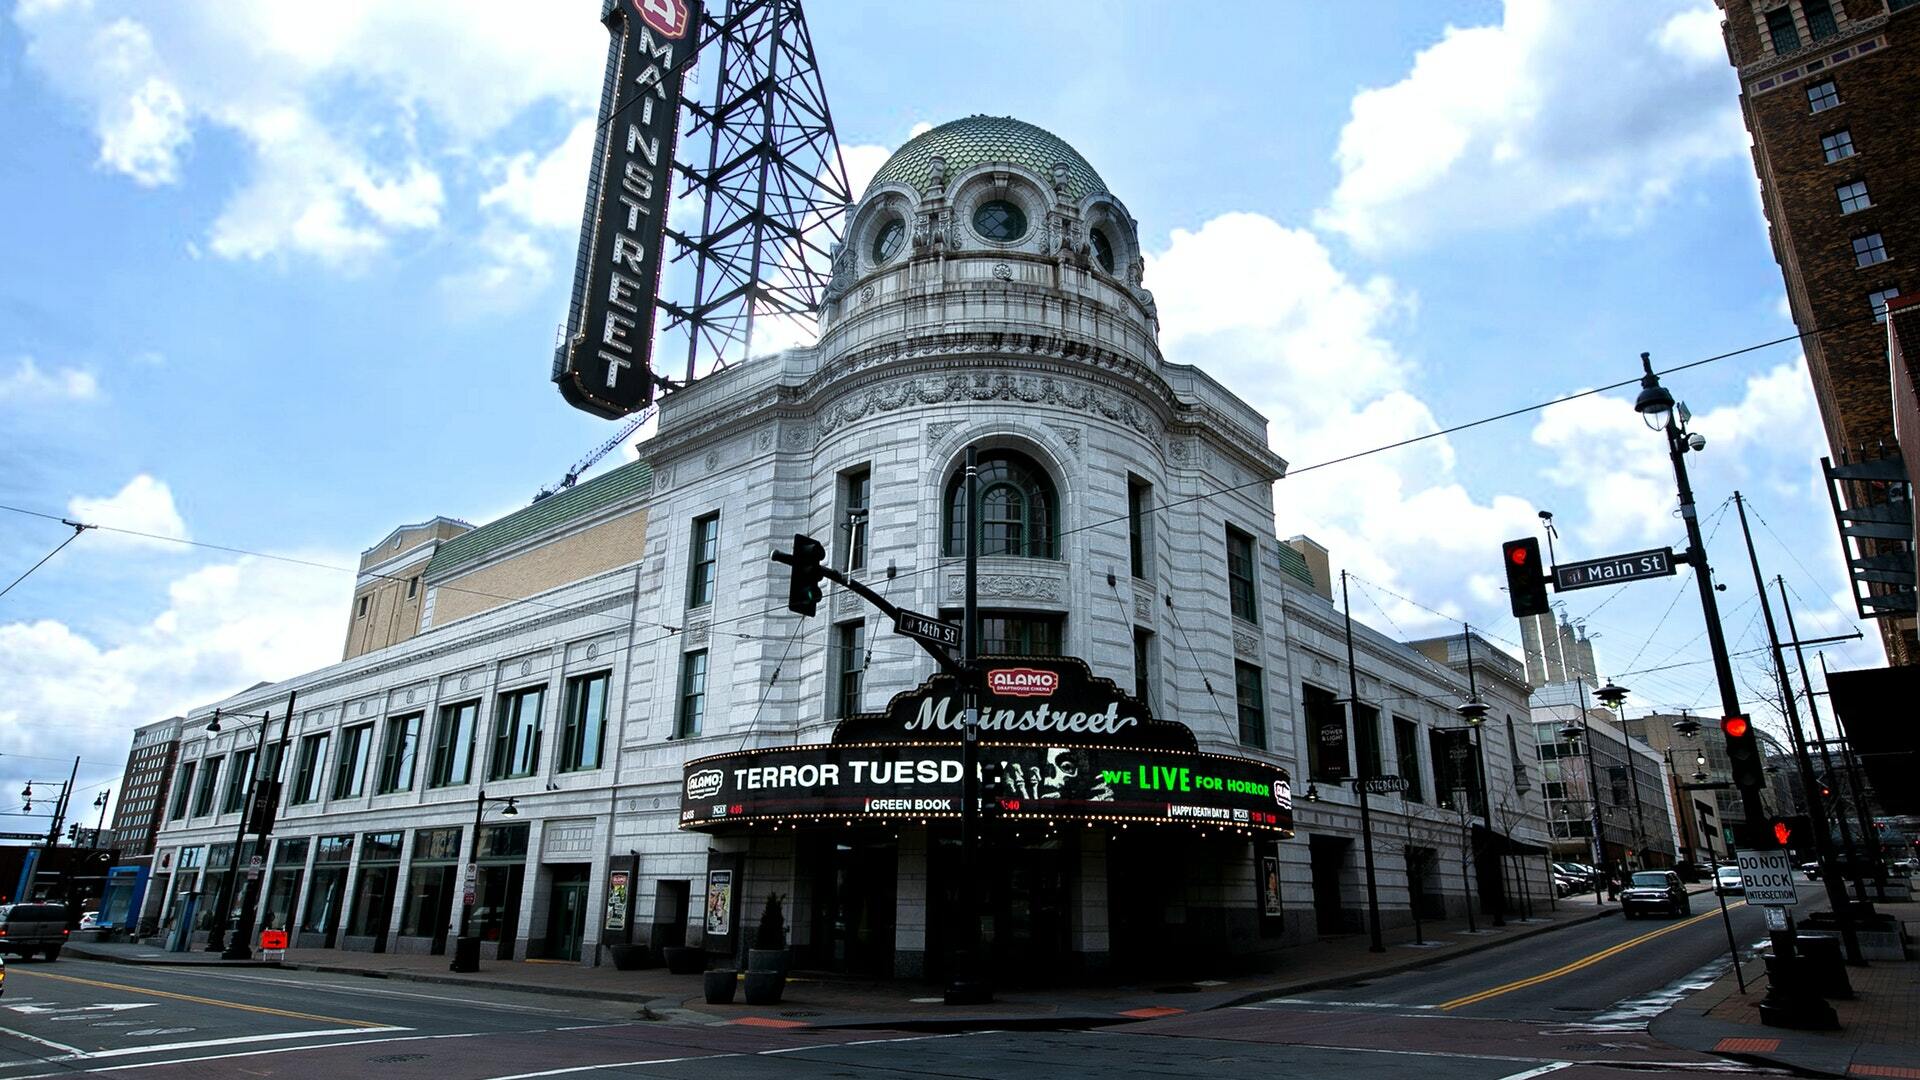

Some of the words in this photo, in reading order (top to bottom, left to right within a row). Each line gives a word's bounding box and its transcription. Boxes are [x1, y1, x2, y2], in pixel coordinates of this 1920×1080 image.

[598, 26, 673, 389] MAINSTREET
[1588, 561, 1635, 581] Main
[1641, 555, 1661, 573] St
[917, 620, 940, 639] 14th
[944, 627, 955, 643] St
[994, 673, 1053, 686] ALAMO
[1320, 728, 1344, 736] POWER
[1326, 734, 1343, 742] LIGHT
[689, 773, 719, 790] ALAMO
[733, 763, 839, 791] TERROR
[1102, 770, 1131, 785] WE
[1139, 765, 1190, 792] LIVE
[1195, 775, 1223, 791] FOR
[1227, 779, 1270, 797] HORROR
[1354, 778, 1410, 793] CESTERFIELD
[871, 799, 913, 811] GREEN
[915, 798, 951, 810] BOOK
[1172, 805, 1193, 816] HAPPY
[1193, 806, 1211, 817] DEATH
[1212, 807, 1222, 818] DAY
[1739, 857, 1758, 869] DO
[1760, 856, 1785, 869] NOT
[1743, 874, 1792, 887] BLOCK
[1747, 890, 1794, 900] INTERSECTION
